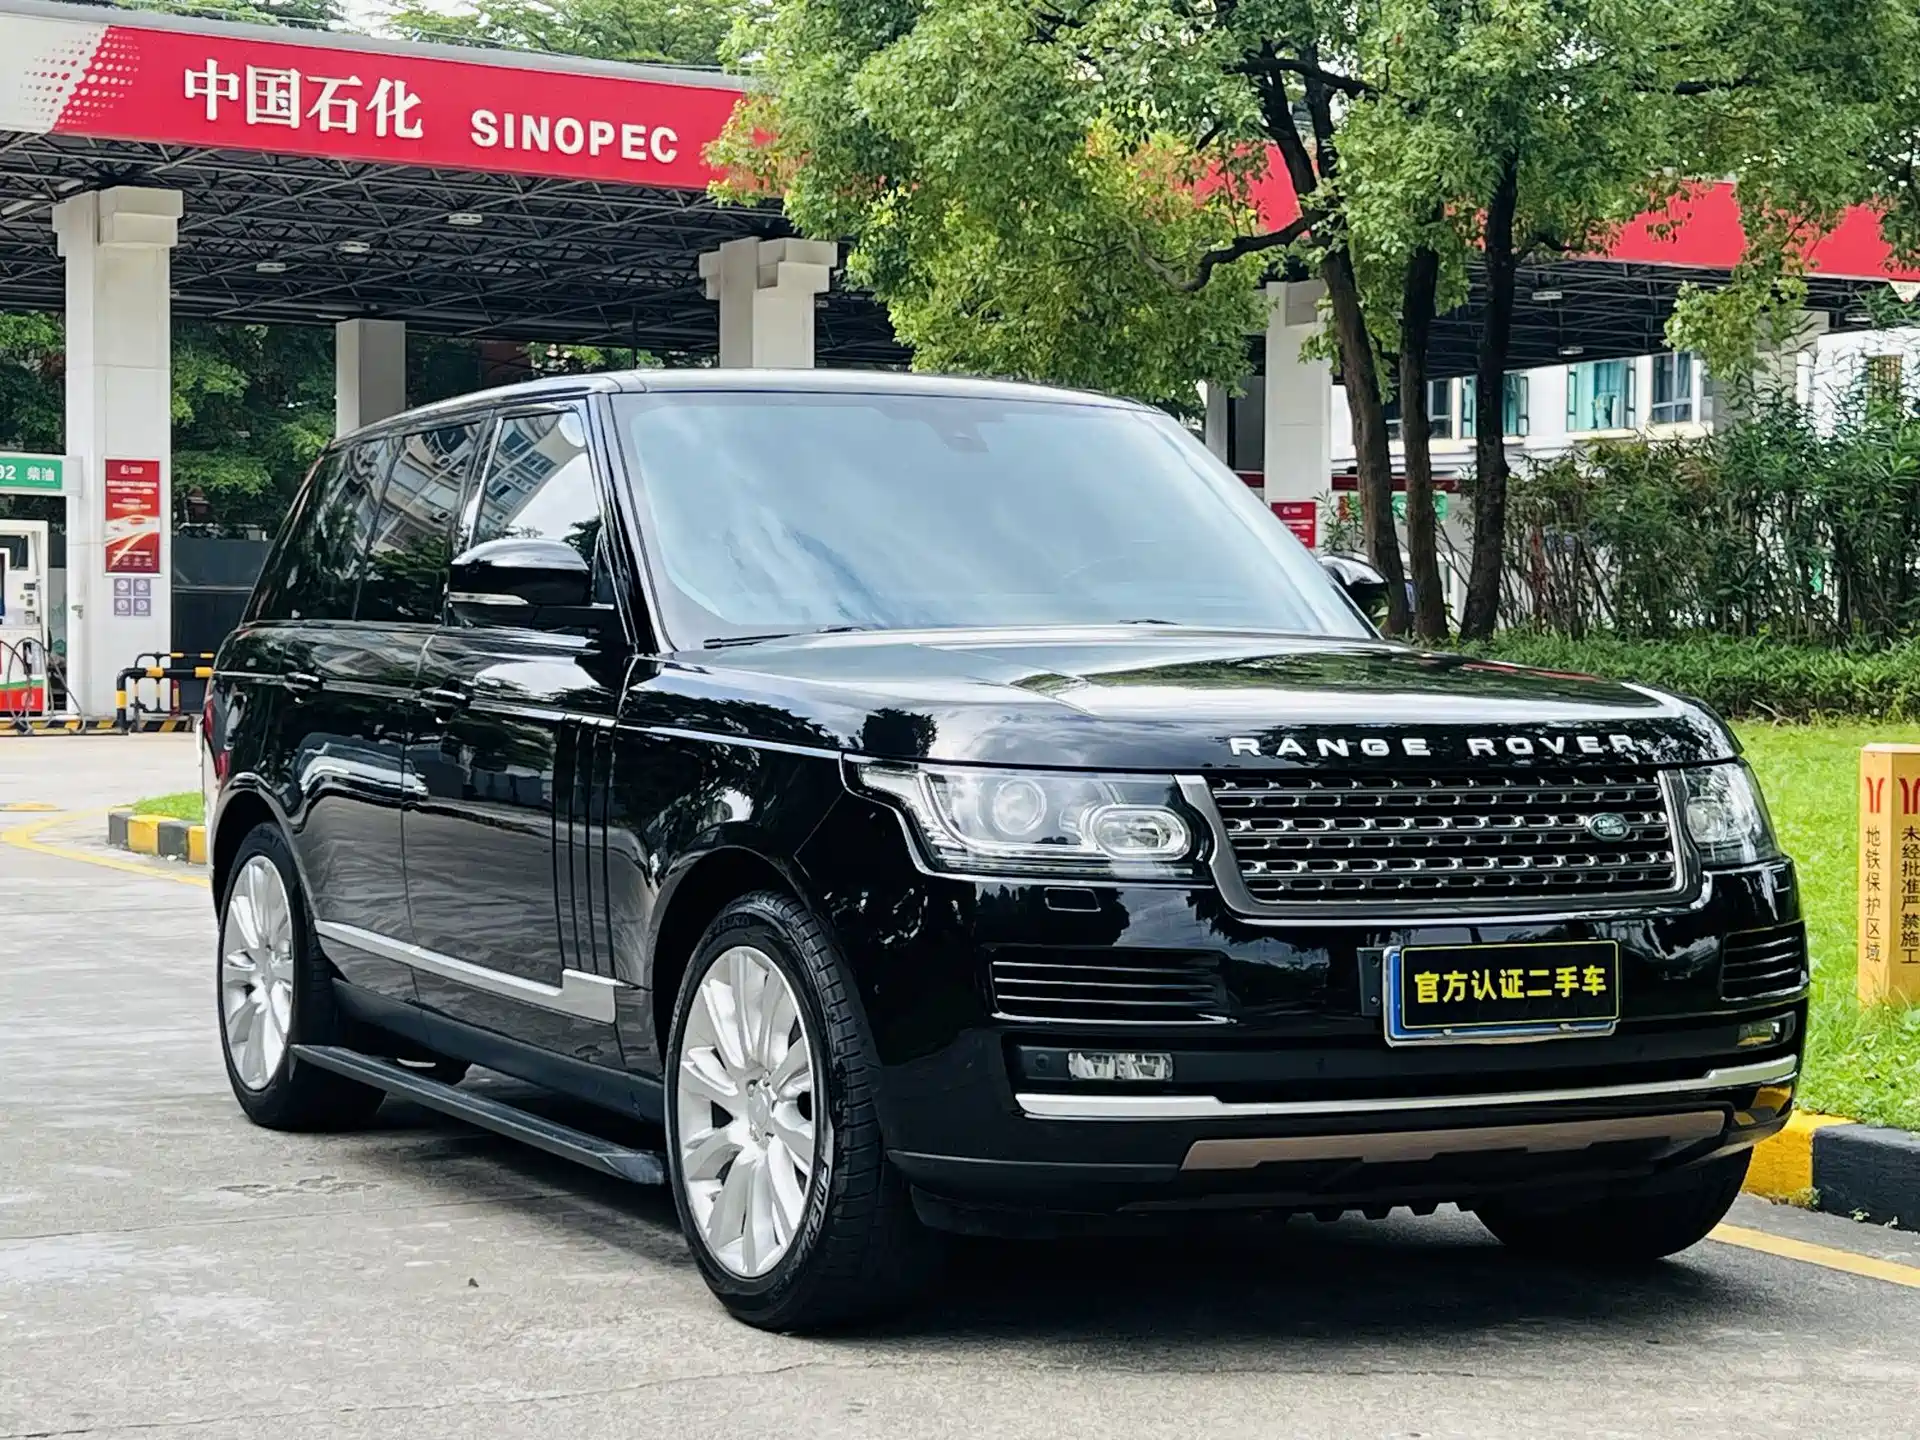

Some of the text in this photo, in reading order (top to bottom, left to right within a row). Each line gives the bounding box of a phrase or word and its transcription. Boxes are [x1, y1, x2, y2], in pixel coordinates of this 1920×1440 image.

[184, 59, 424, 138] 中国石化
[470, 109, 679, 164] SINOPEC
[27, 466, 55, 481] 柴油
[1231, 734, 1640, 757] RANGE ROVER
[1865, 826, 1881, 963] 地铁保护区域
[1900, 825, 1920, 964] 未经批准严禁施工
[1414, 964, 1607, 1003] 官方认证二手车
